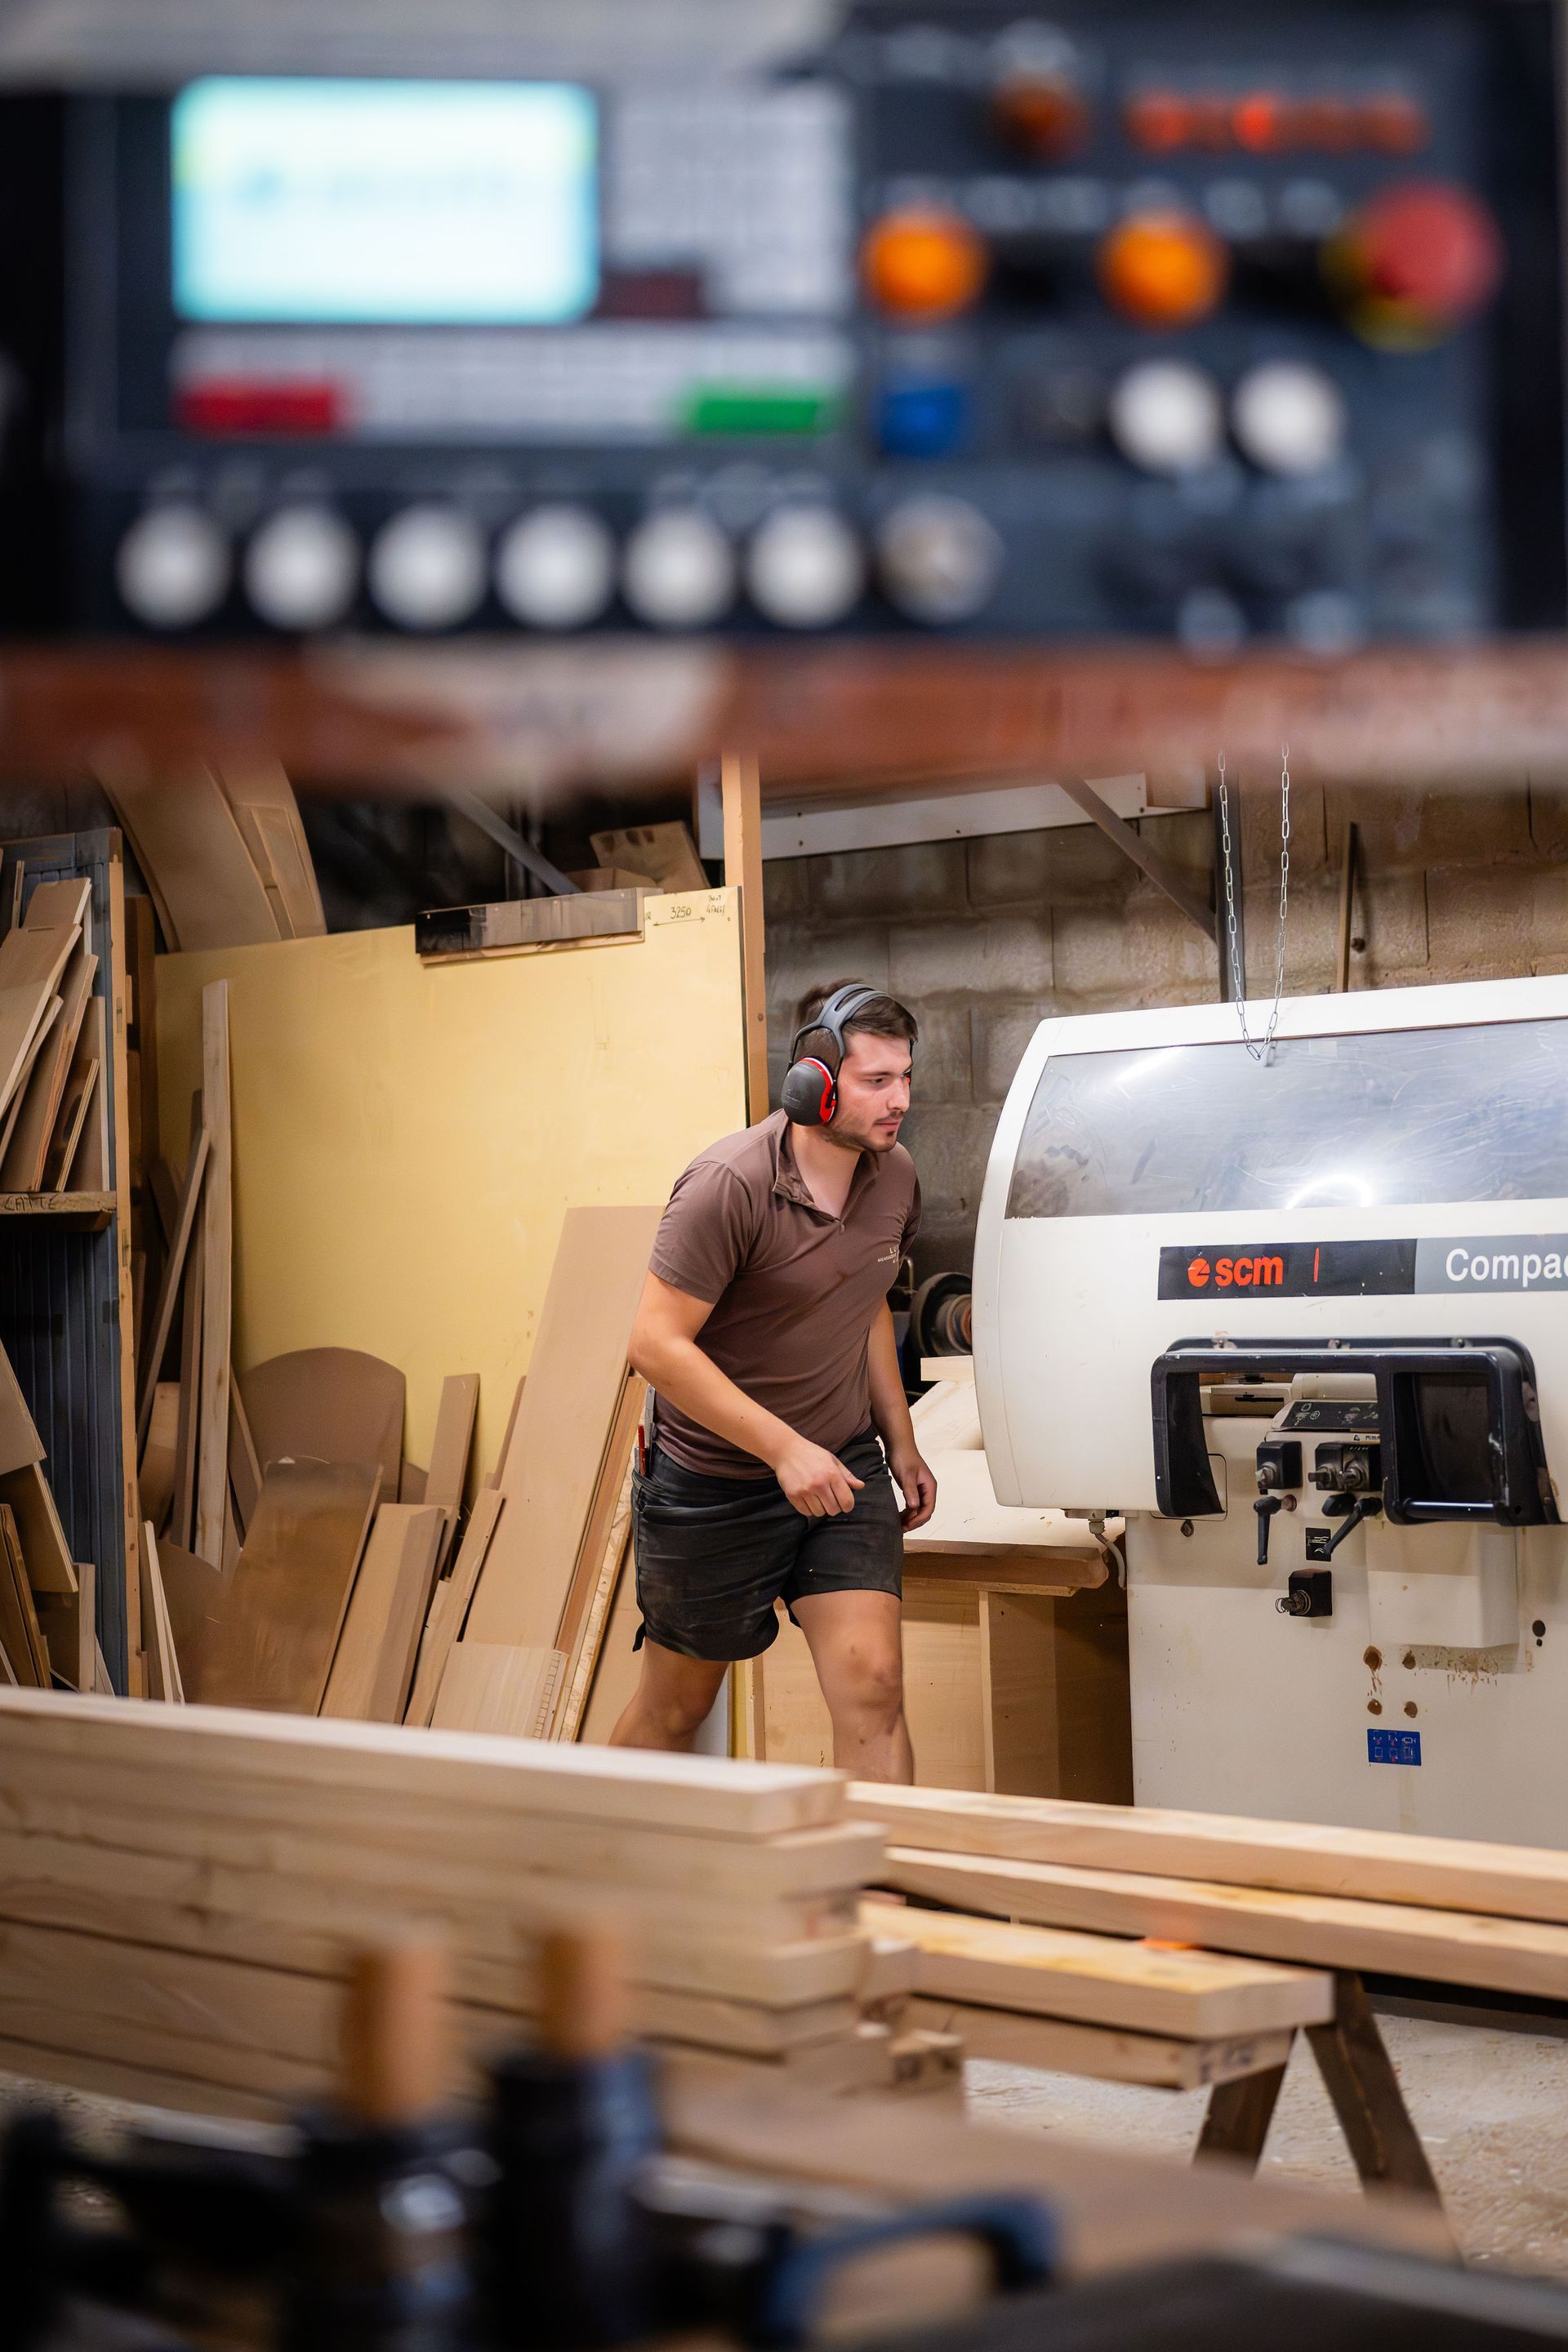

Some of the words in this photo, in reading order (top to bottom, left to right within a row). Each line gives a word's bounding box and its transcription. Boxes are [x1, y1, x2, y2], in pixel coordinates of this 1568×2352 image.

[670, 906, 692, 920] 3250
[1214, 1256, 1283, 1287] scm
[1446, 1248, 1568, 1288] Compa
